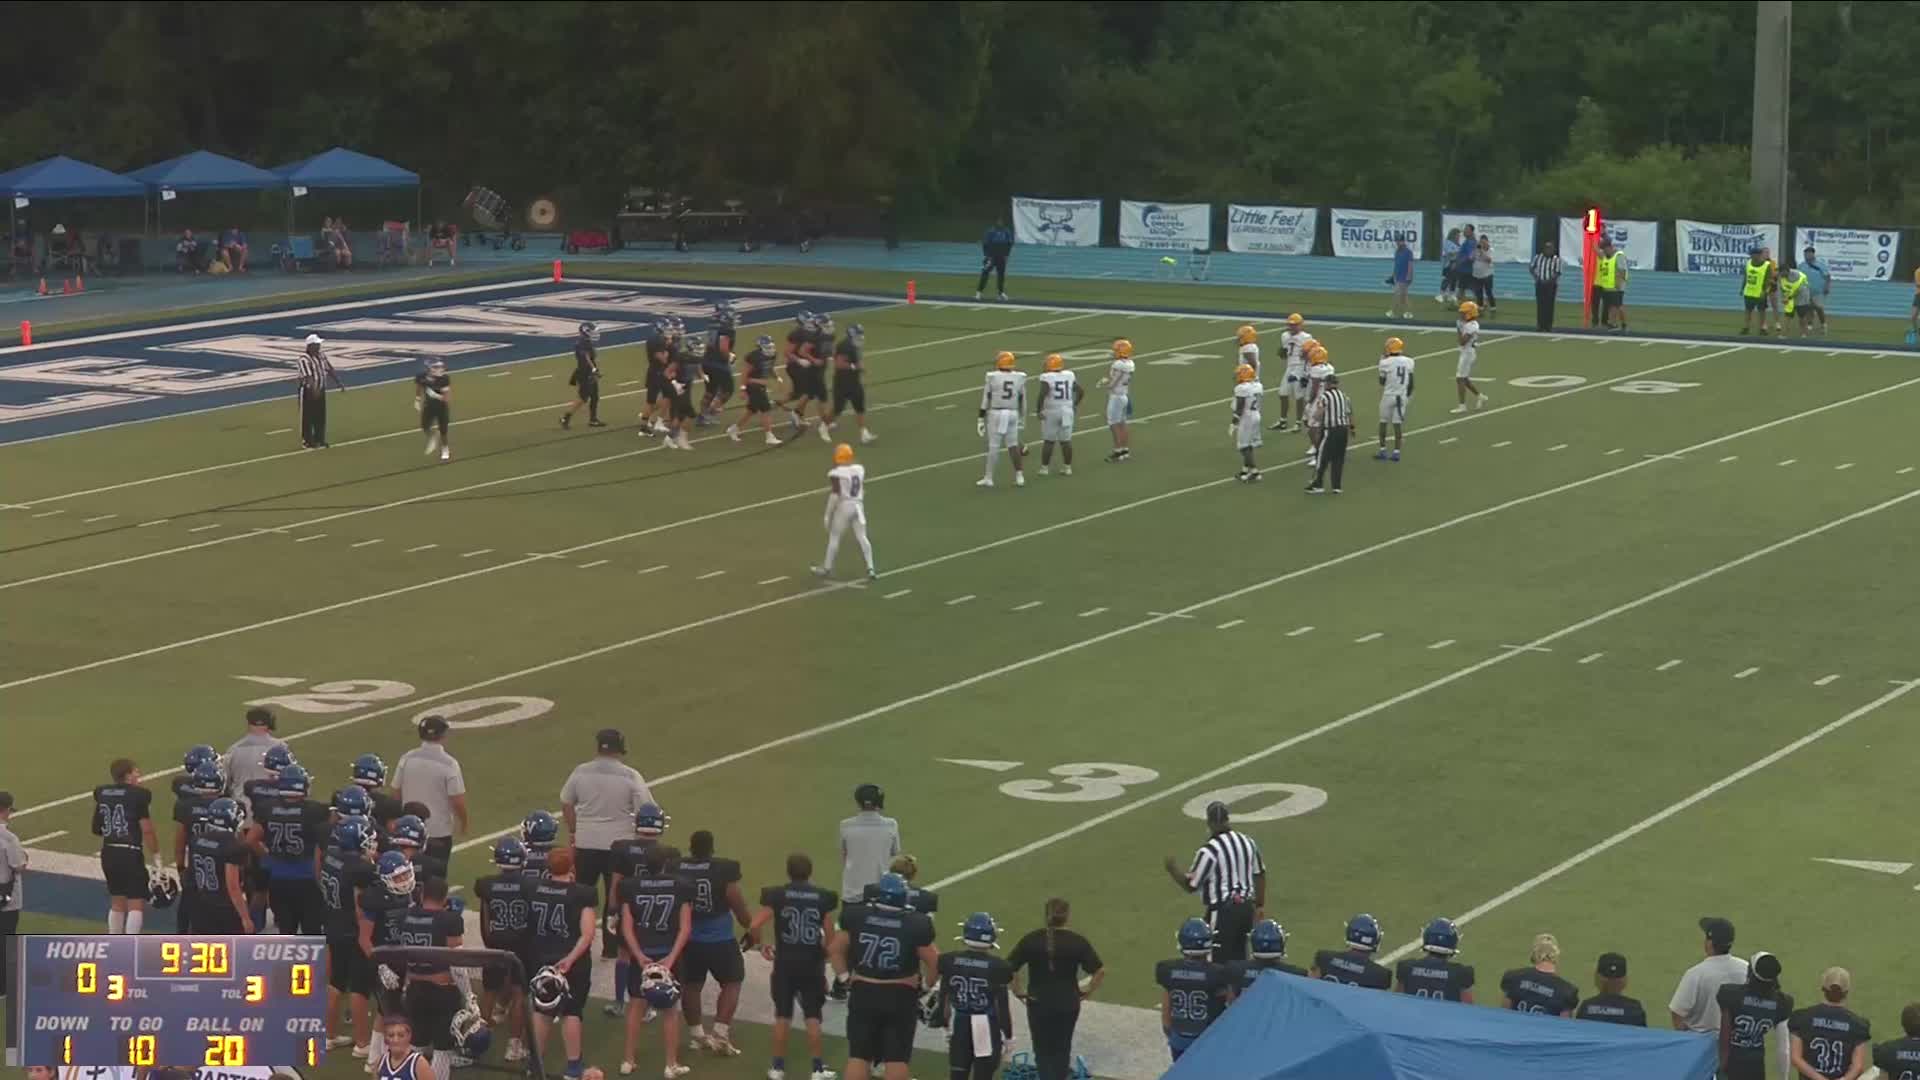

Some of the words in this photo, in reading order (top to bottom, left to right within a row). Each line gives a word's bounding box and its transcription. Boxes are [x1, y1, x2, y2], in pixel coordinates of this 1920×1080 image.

[1231, 209, 1265, 225] Little
[1270, 210, 1304, 226] Feet
[1587, 209, 1597, 232] 1
[1341, 228, 1418, 243] ENGLAND
[1695, 255, 1750, 265] SUPERVISO
[1396, 366, 1406, 385] 4
[1001, 380, 1014, 400] 5
[1054, 380, 1069, 400] 51
[999, 762, 1328, 822] 30
[100, 803, 130, 837] 34
[267, 822, 305, 856] 75
[532, 901, 570, 938] 74
[636, 895, 675, 931] 77
[781, 906, 822, 944] 36
[858, 932, 900, 968] 72
